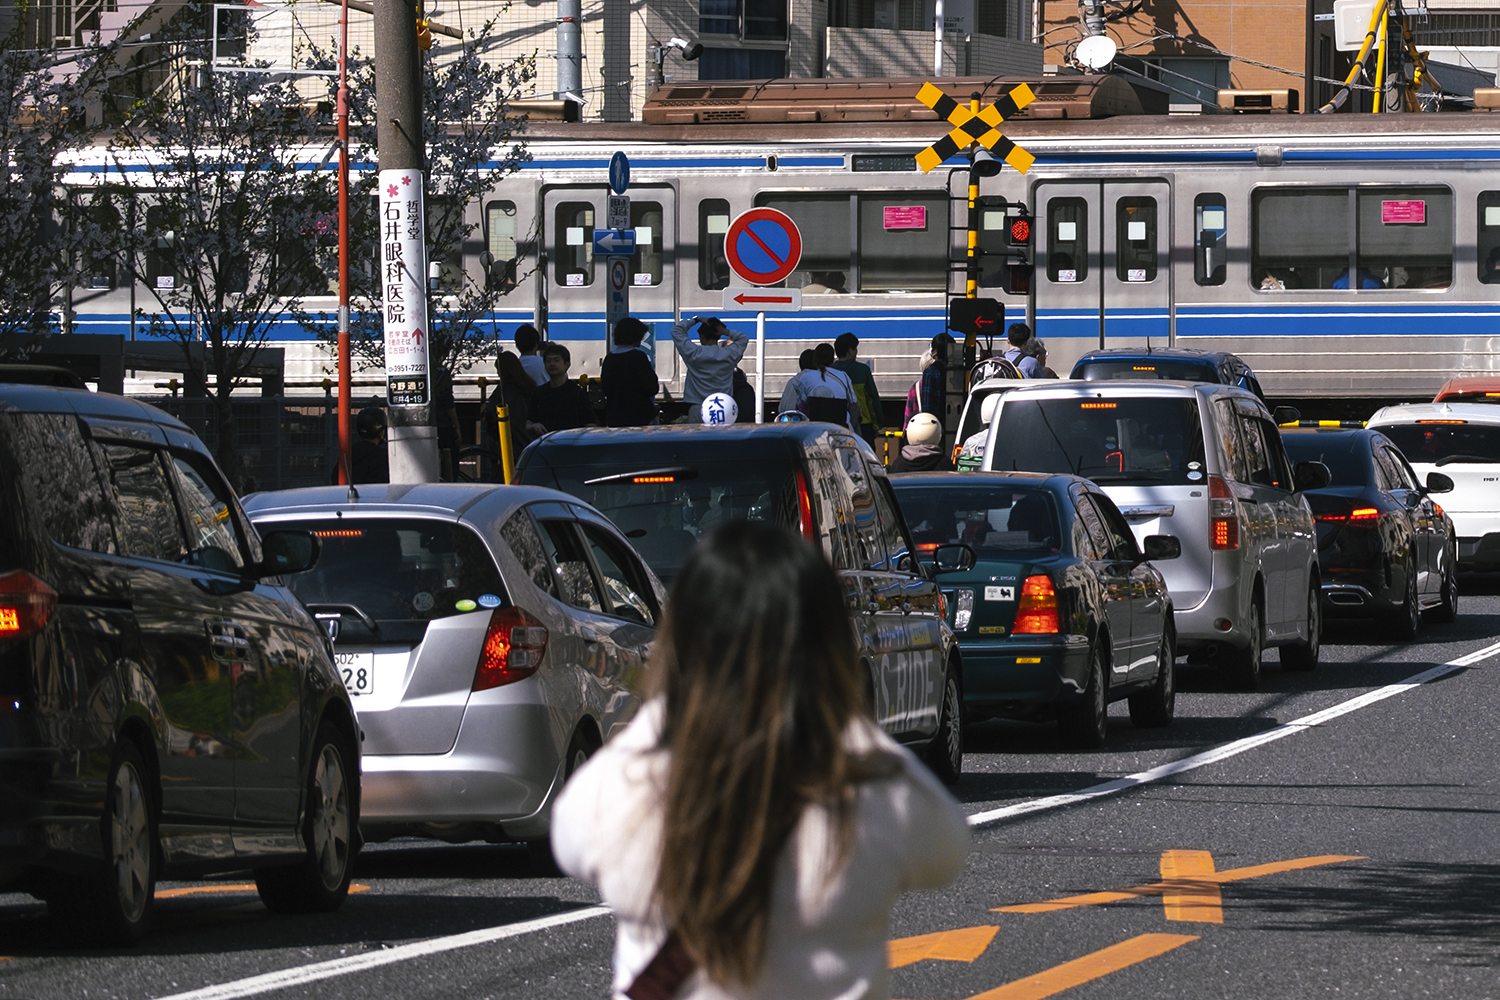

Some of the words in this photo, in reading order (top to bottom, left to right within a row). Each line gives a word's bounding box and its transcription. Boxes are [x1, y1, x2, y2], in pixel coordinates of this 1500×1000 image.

[406, 200, 420, 241] 哲学堂
[383, 200, 406, 324] 石井眼科医院
[708, 396, 726, 425] 大和
[342, 668, 367, 690] 28
